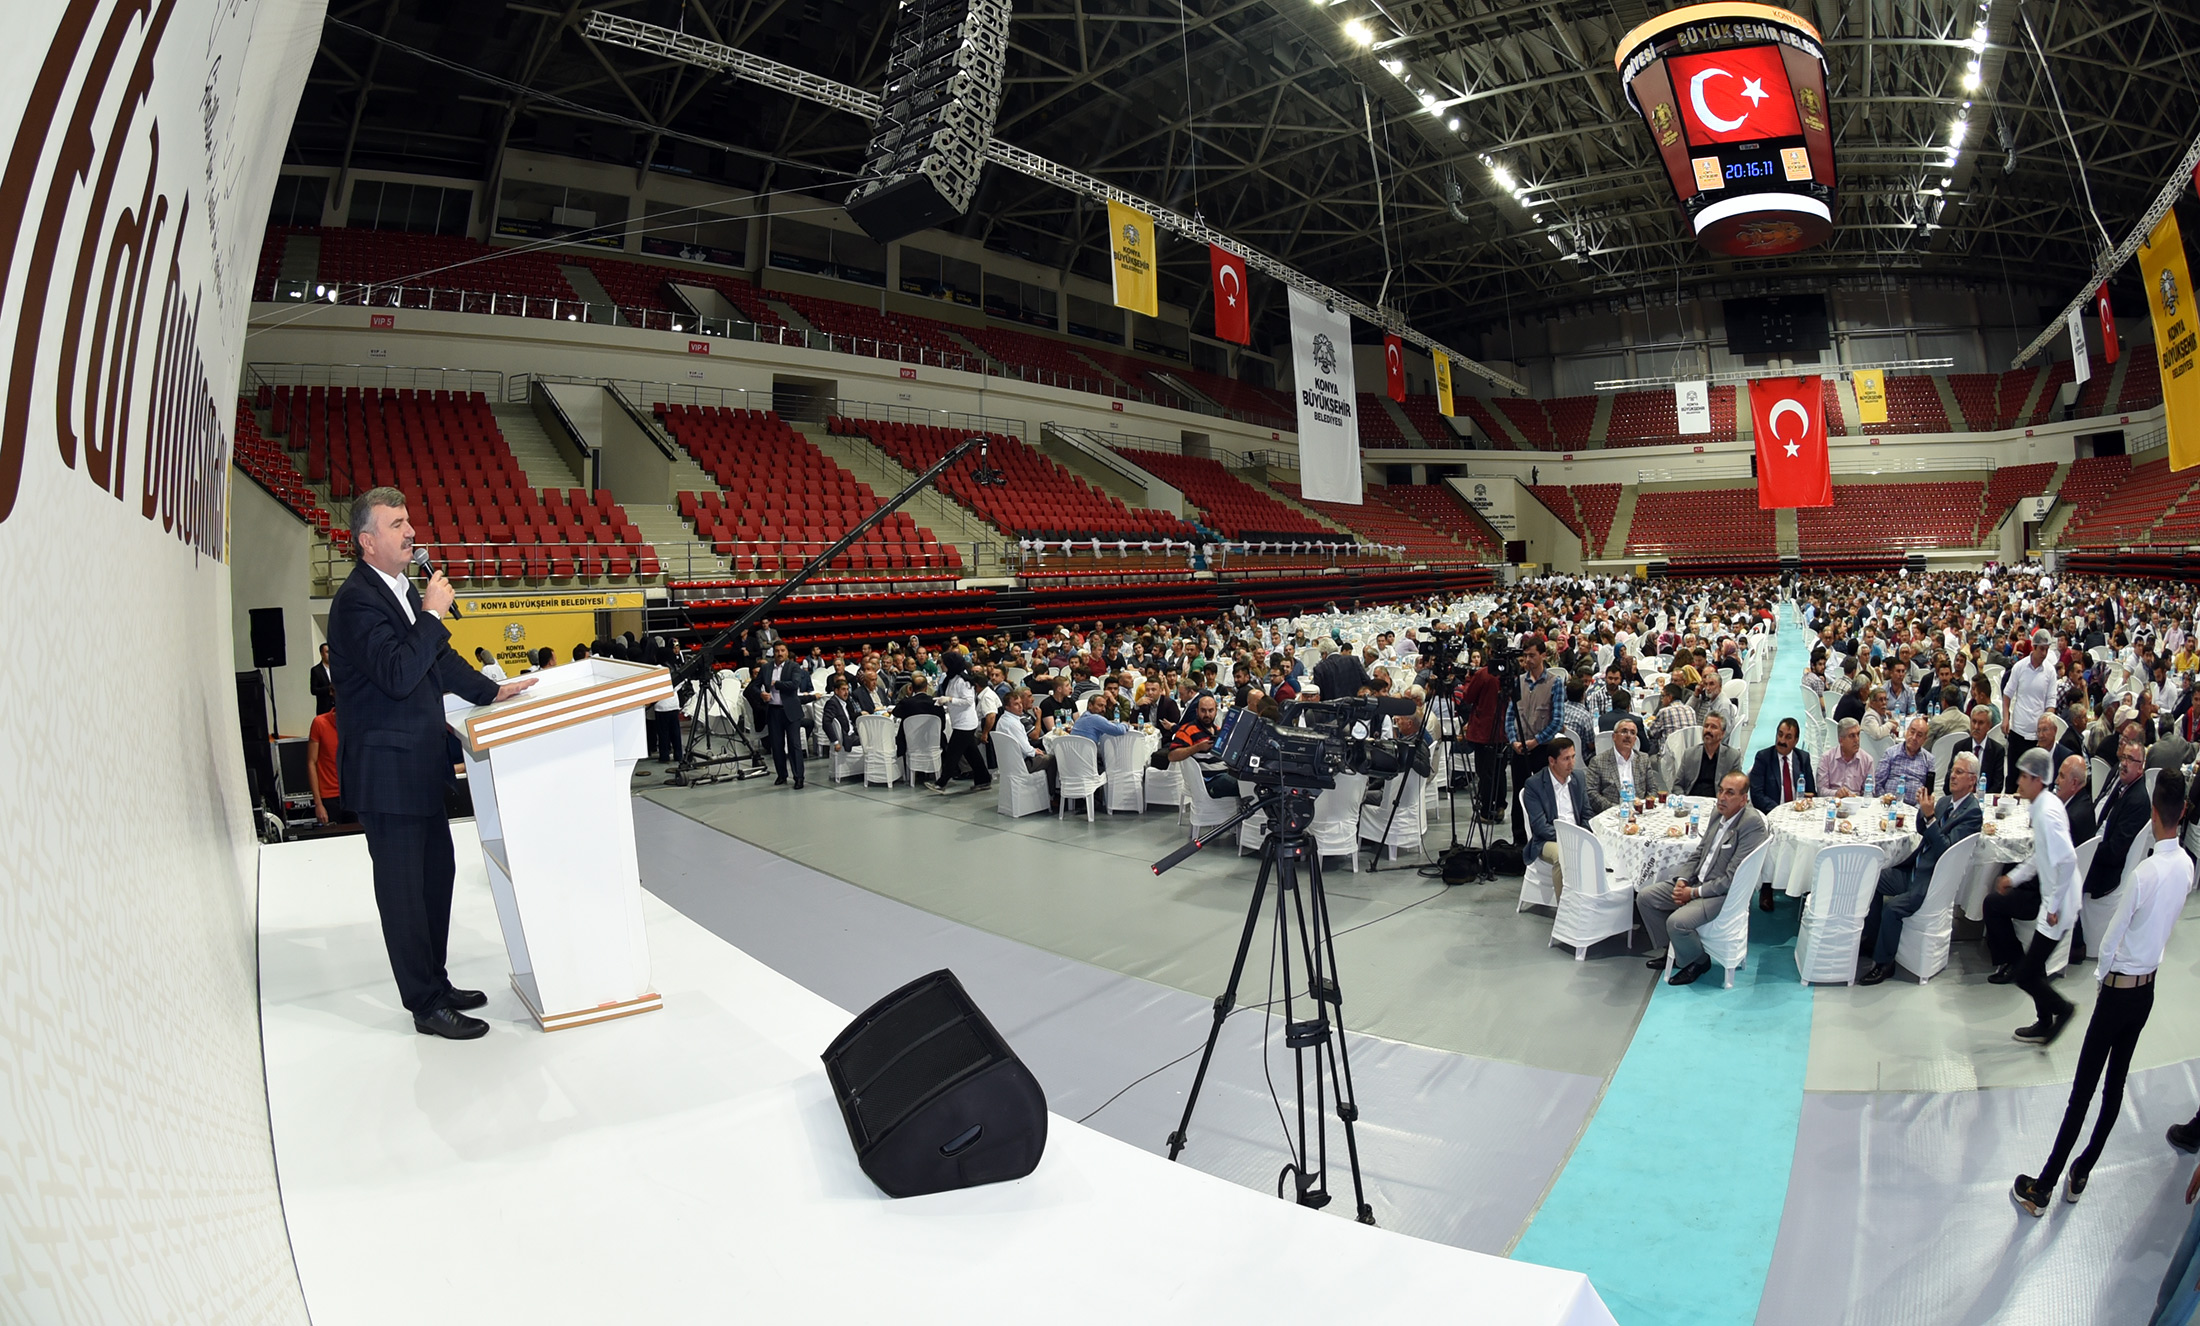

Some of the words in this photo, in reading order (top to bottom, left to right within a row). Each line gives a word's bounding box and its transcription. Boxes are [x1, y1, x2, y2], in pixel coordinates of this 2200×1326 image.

[1676, 23, 1780, 47] BÜYÜKŞEHİR
[1725, 160, 1774, 180] 20:16:11
[1114, 250, 1150, 271] BÜYÜKŞEHİR
[1122, 246, 1141, 258] KONYA
[373, 317, 386, 326] VIP
[2167, 318, 2186, 342] KONYA
[690, 343, 702, 352] VIP
[702, 344, 708, 352] 4
[2162, 329, 2198, 370] BÜYÜKŞEHİR
[1315, 377, 1339, 396] KONYA
[1302, 388, 1351, 418] BÜYÜKŞEHİR
[1314, 411, 1343, 427] BELEDİYESİ
[481, 601, 508, 610] KONYA
[509, 598, 559, 609] BÜYÜKŞEHİR
[561, 596, 604, 607] BELEDİYESİ
[496, 651, 529, 660] BÜYÜKŞEH
